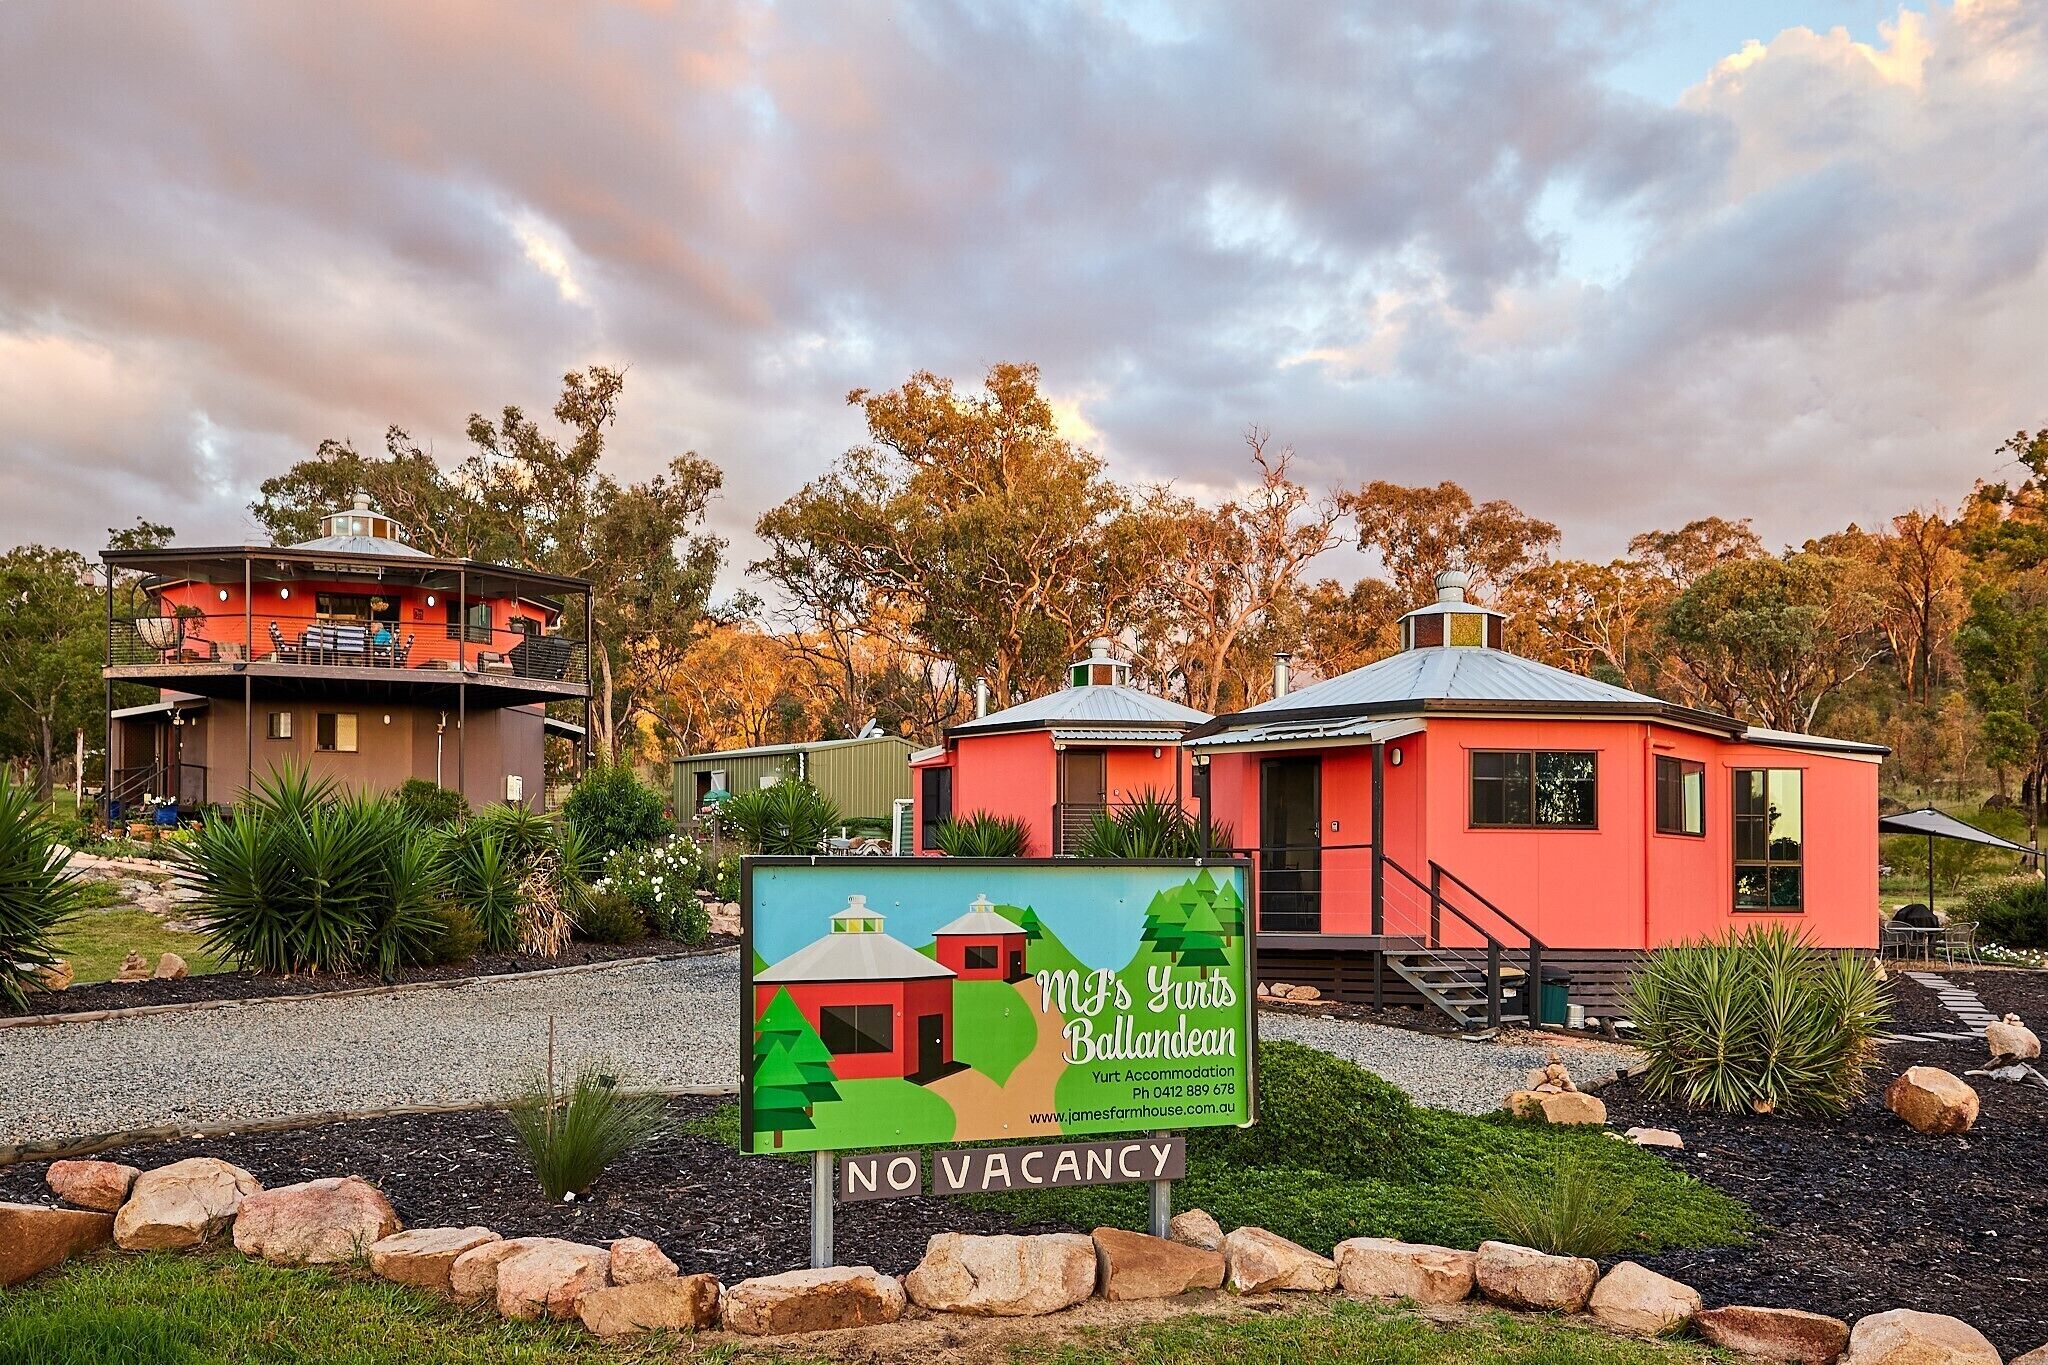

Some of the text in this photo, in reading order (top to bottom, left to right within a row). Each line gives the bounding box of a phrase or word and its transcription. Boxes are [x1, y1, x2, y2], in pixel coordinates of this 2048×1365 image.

[1036, 965, 1236, 1017] MJ's Yurts
[1062, 1013, 1236, 1065] Ballandean
[1092, 1065, 1235, 1084] Yurt Accommodation
[1133, 1082, 1235, 1100] Ph 0412 889 678
[1029, 1102, 1236, 1126] www.jamesfarmhouse.com.au
[848, 1143, 1172, 1194] NO VACANCY
